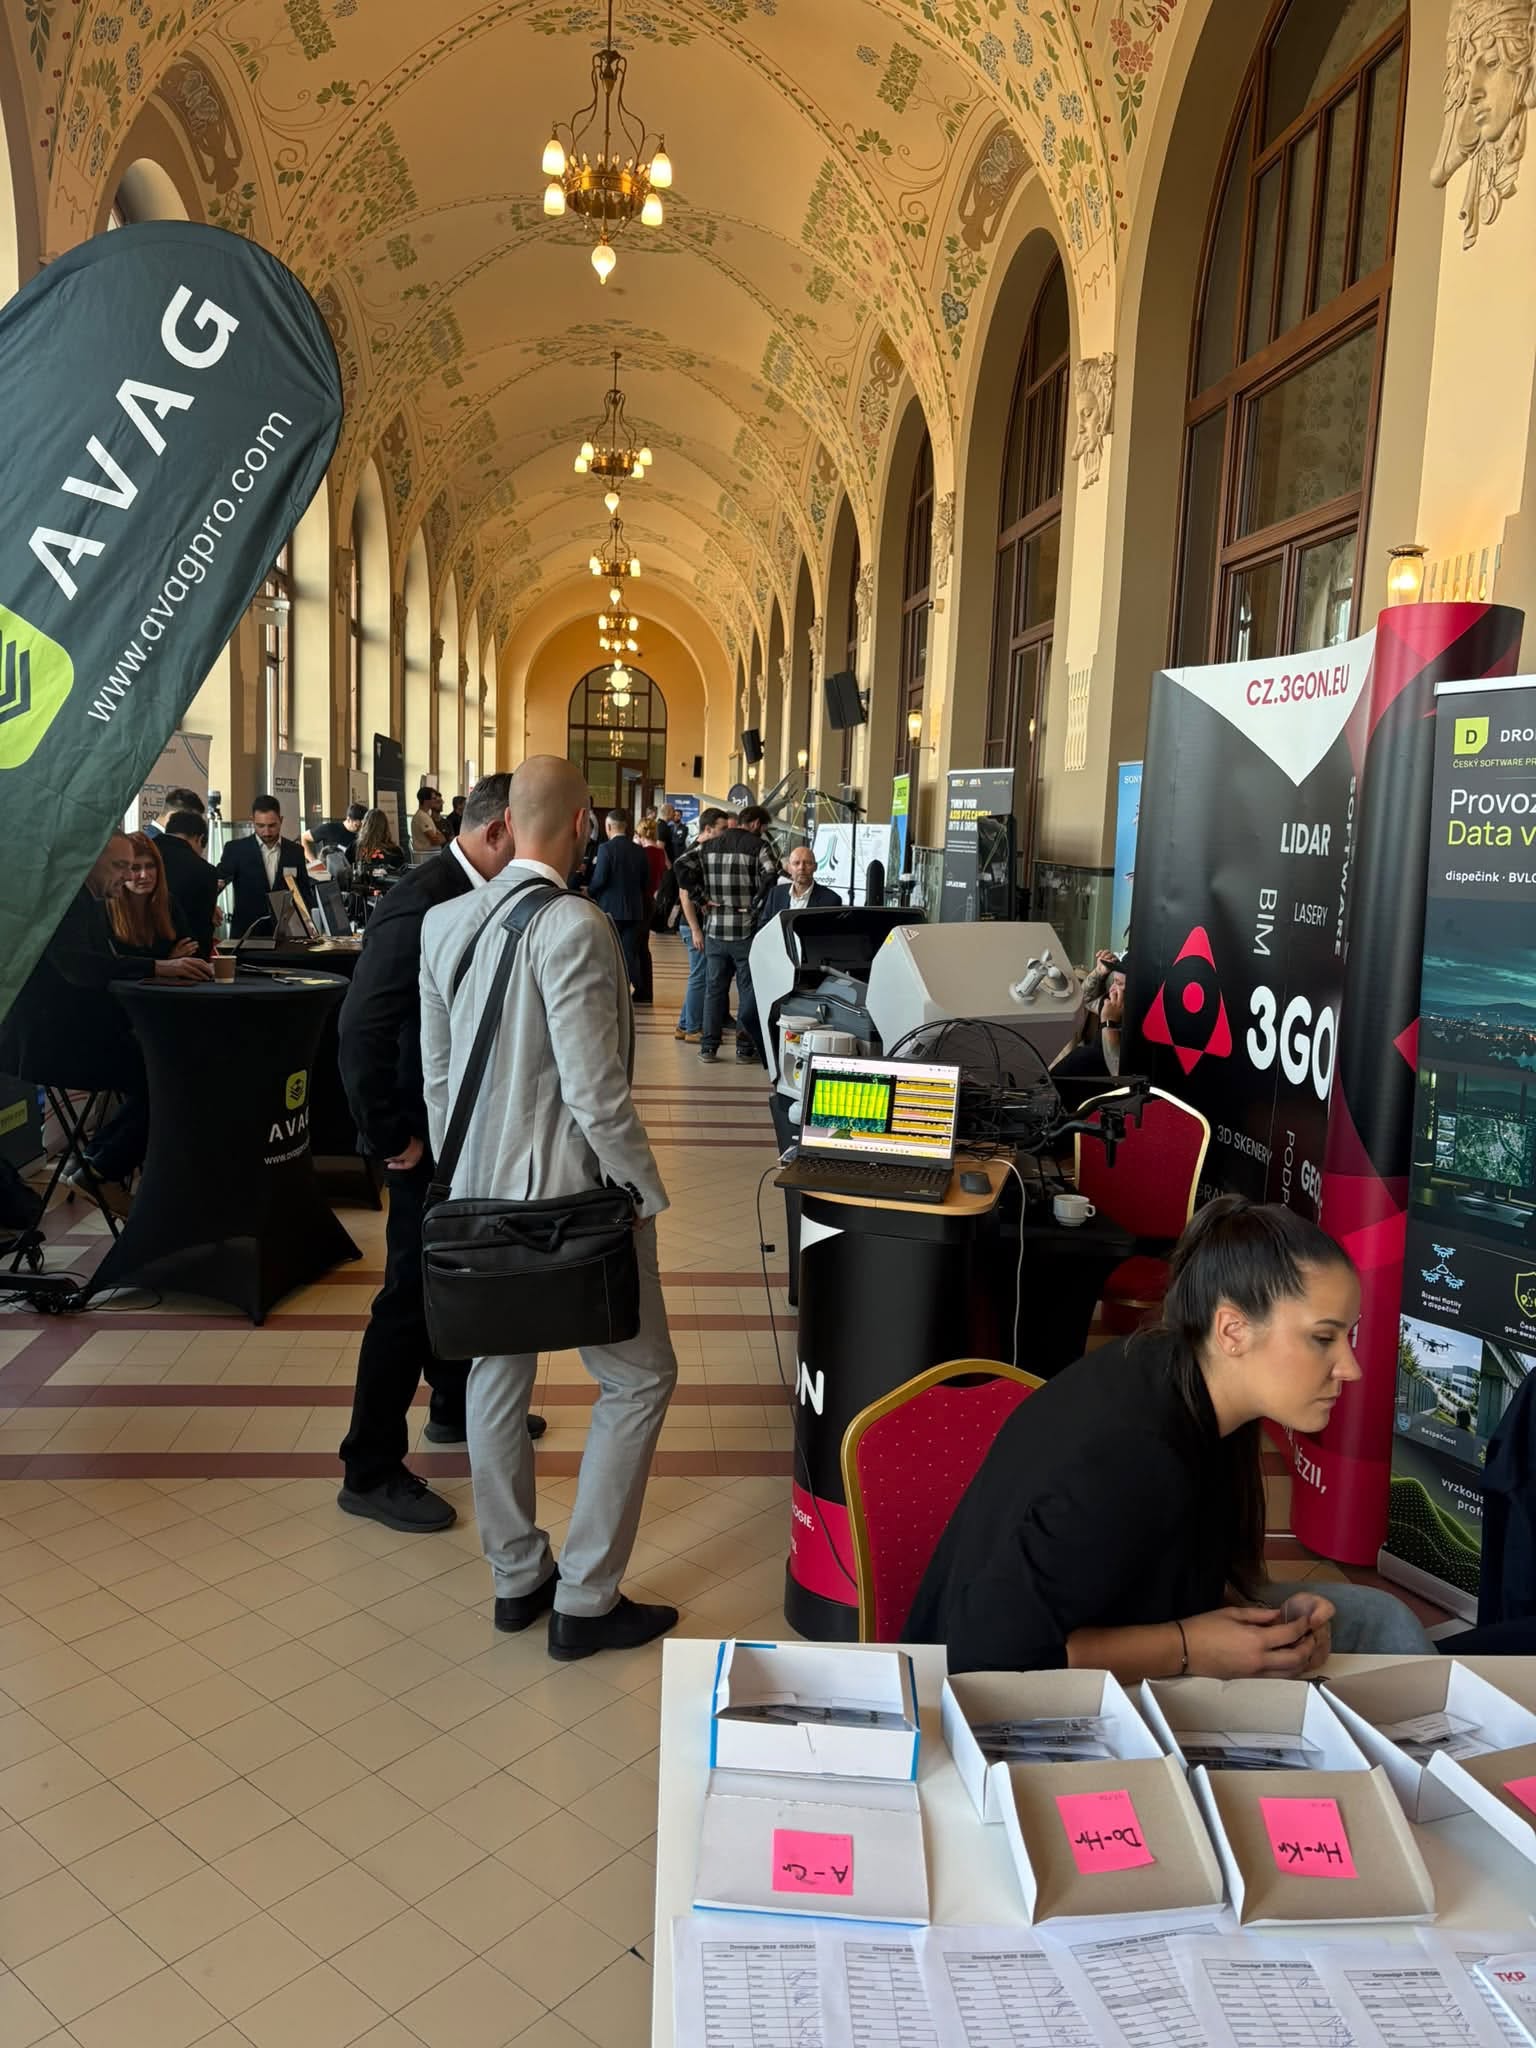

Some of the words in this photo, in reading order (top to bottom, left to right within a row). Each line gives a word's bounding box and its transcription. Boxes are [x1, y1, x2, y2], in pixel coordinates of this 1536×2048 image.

[28, 284, 240, 601] AVAG
[87, 410, 293, 724] www.avagpro.com
[1245, 663, 1350, 706] CZ.3GON.EU
[1500, 728, 1536, 743] DRO
[1452, 757, 1479, 769] ČESKÝ
[1480, 757, 1524, 768] SOFTWARE
[1280, 822, 1332, 857] LIDAR
[1447, 819, 1512, 847] Data
[1445, 870, 1500, 884] dispečink
[1251, 887, 1279, 957] BIM
[1293, 902, 1328, 928] LASERY
[1246, 985, 1338, 1102] 3GO
[1216, 1124, 1233, 1146] 3D
[1233, 1131, 1273, 1167] SKENERY
[1280, 1129, 1297, 1208] PODP
[1300, 1159, 1324, 1206] GEO
[795, 1354, 825, 1417] N
[792, 1504, 815, 1533] OGIE,
[1493, 1970, 1527, 1983] TKP
